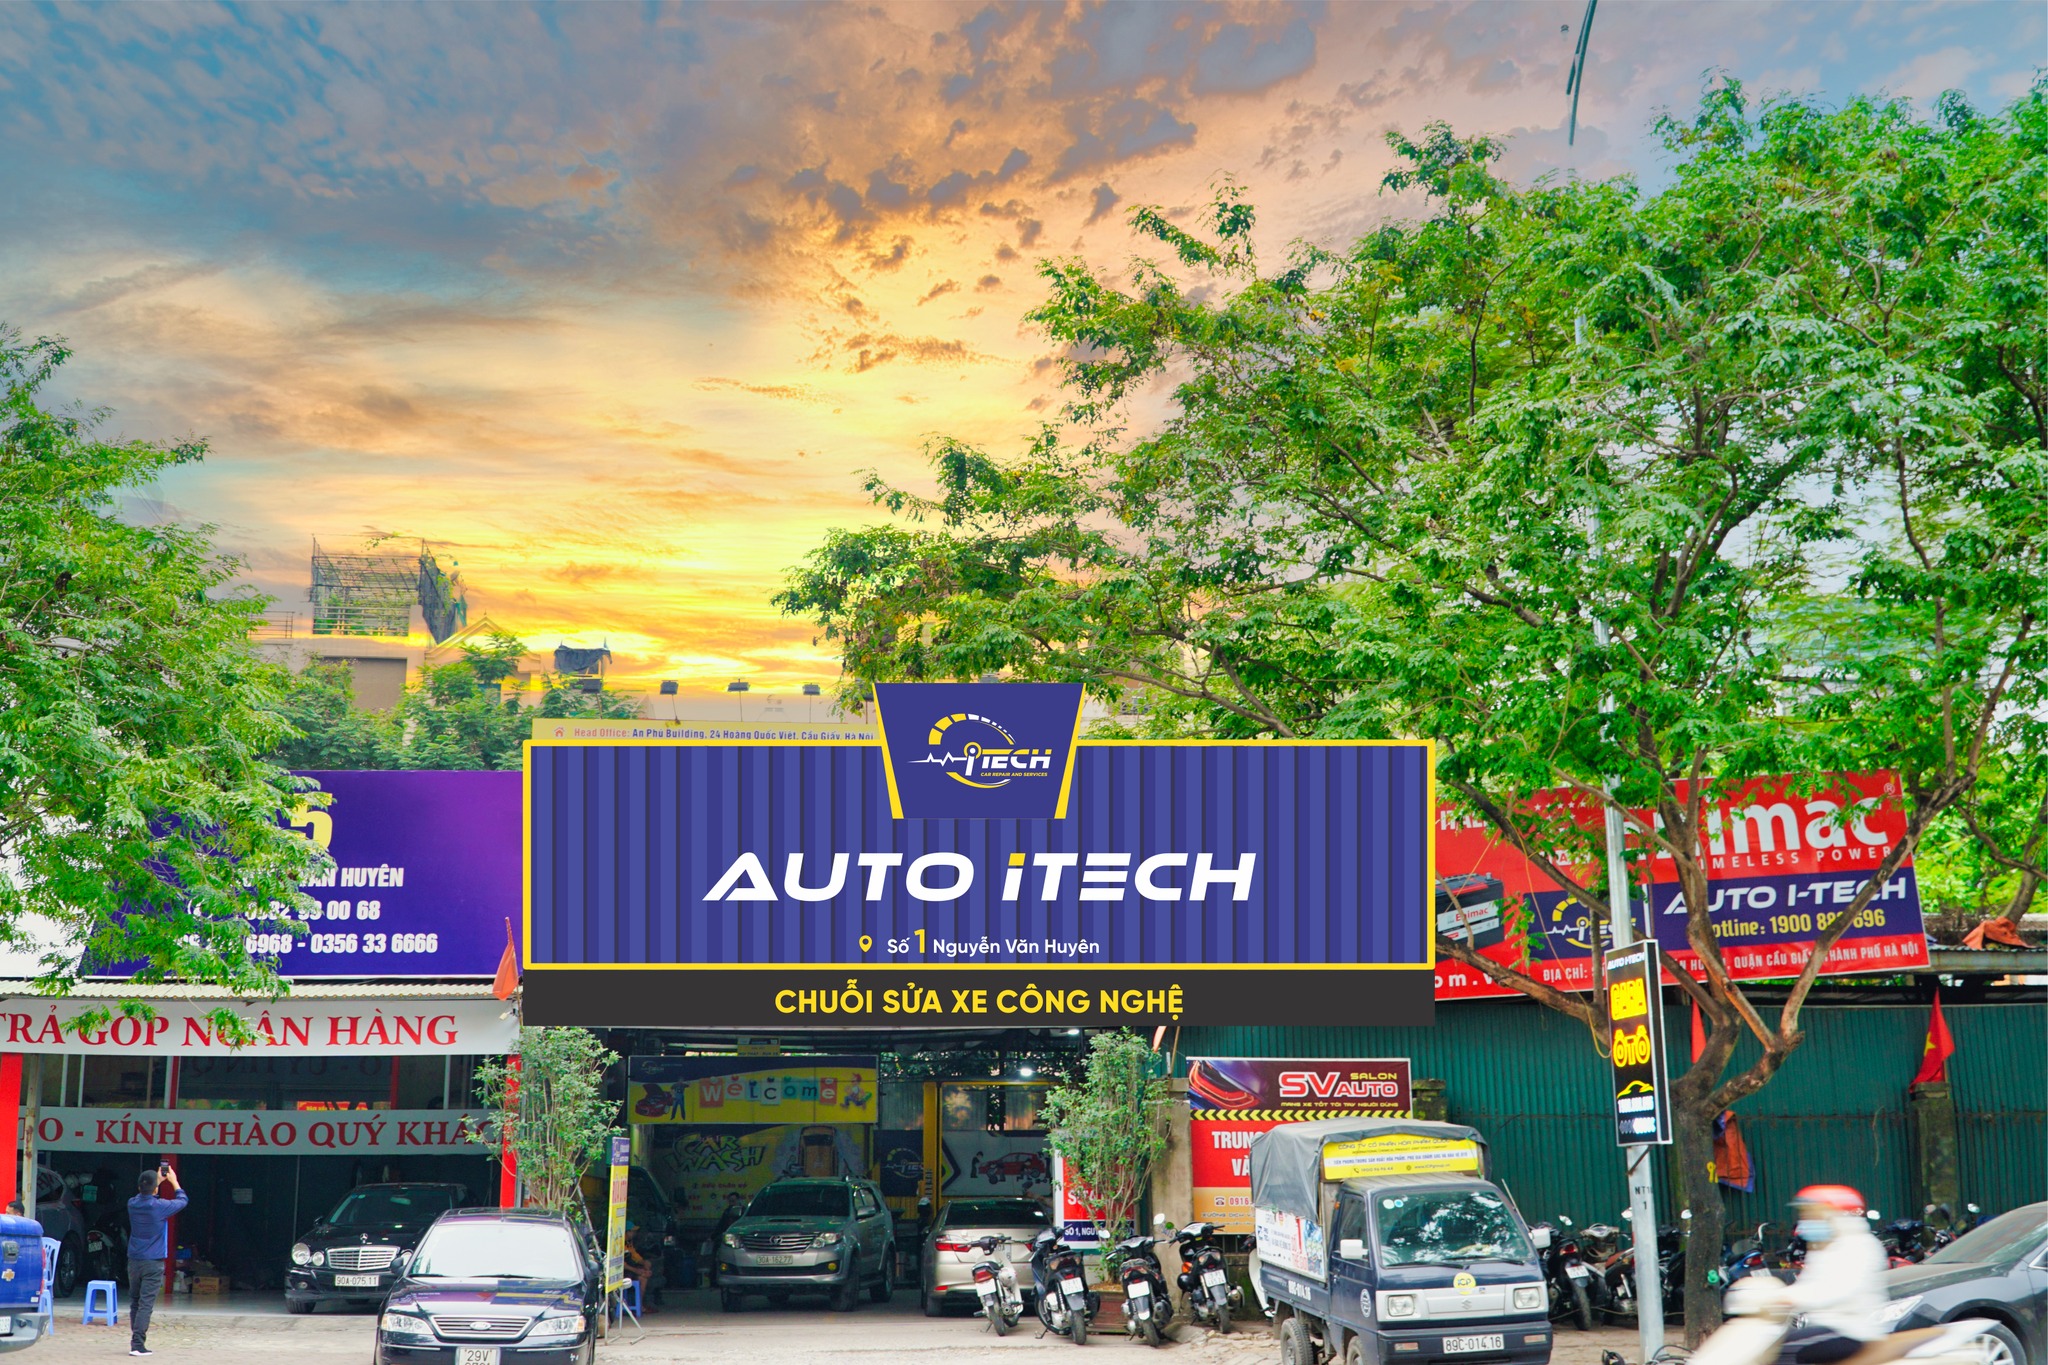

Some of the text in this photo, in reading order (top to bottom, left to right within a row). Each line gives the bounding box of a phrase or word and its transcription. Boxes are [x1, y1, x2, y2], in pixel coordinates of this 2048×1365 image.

[574, 727, 598, 738] Head
[599, 727, 630, 738] Office:
[632, 727, 644, 738] An
[709, 730, 721, 739] 24
[340, 863, 405, 888] HUYÊN
[701, 850, 1257, 903] AUTO iTECH
[326, 900, 351, 921] 00
[356, 900, 381, 921] 68
[1711, 918, 1766, 940] otline:
[1768, 912, 1812, 935] 1900
[245, 933, 293, 955] 6968
[310, 933, 358, 954] 0356
[362, 933, 387, 954] 33
[391, 933, 438, 954] 6666
[886, 928, 1101, 957] Số 1 Nguyễn Văn Huyên
[1860, 942, 1881, 960] PHỐ
[1883, 942, 1898, 957] HÀ
[775, 978, 1184, 1021] CHUỖI SỬA XE CÔNG NGHỆ
[326, 1008, 459, 1047] HÀNG
[1350, 1072, 1398, 1081] SALON
[95, 1113, 183, 1145] KÍNH
[194, 1113, 298, 1147] CHÀO
[308, 1113, 387, 1149] QUÝ
[672, 1133, 740, 1156] CAR
[663, 1146, 766, 1173] WASH
[467, 1350, 489, 1362] 29V
